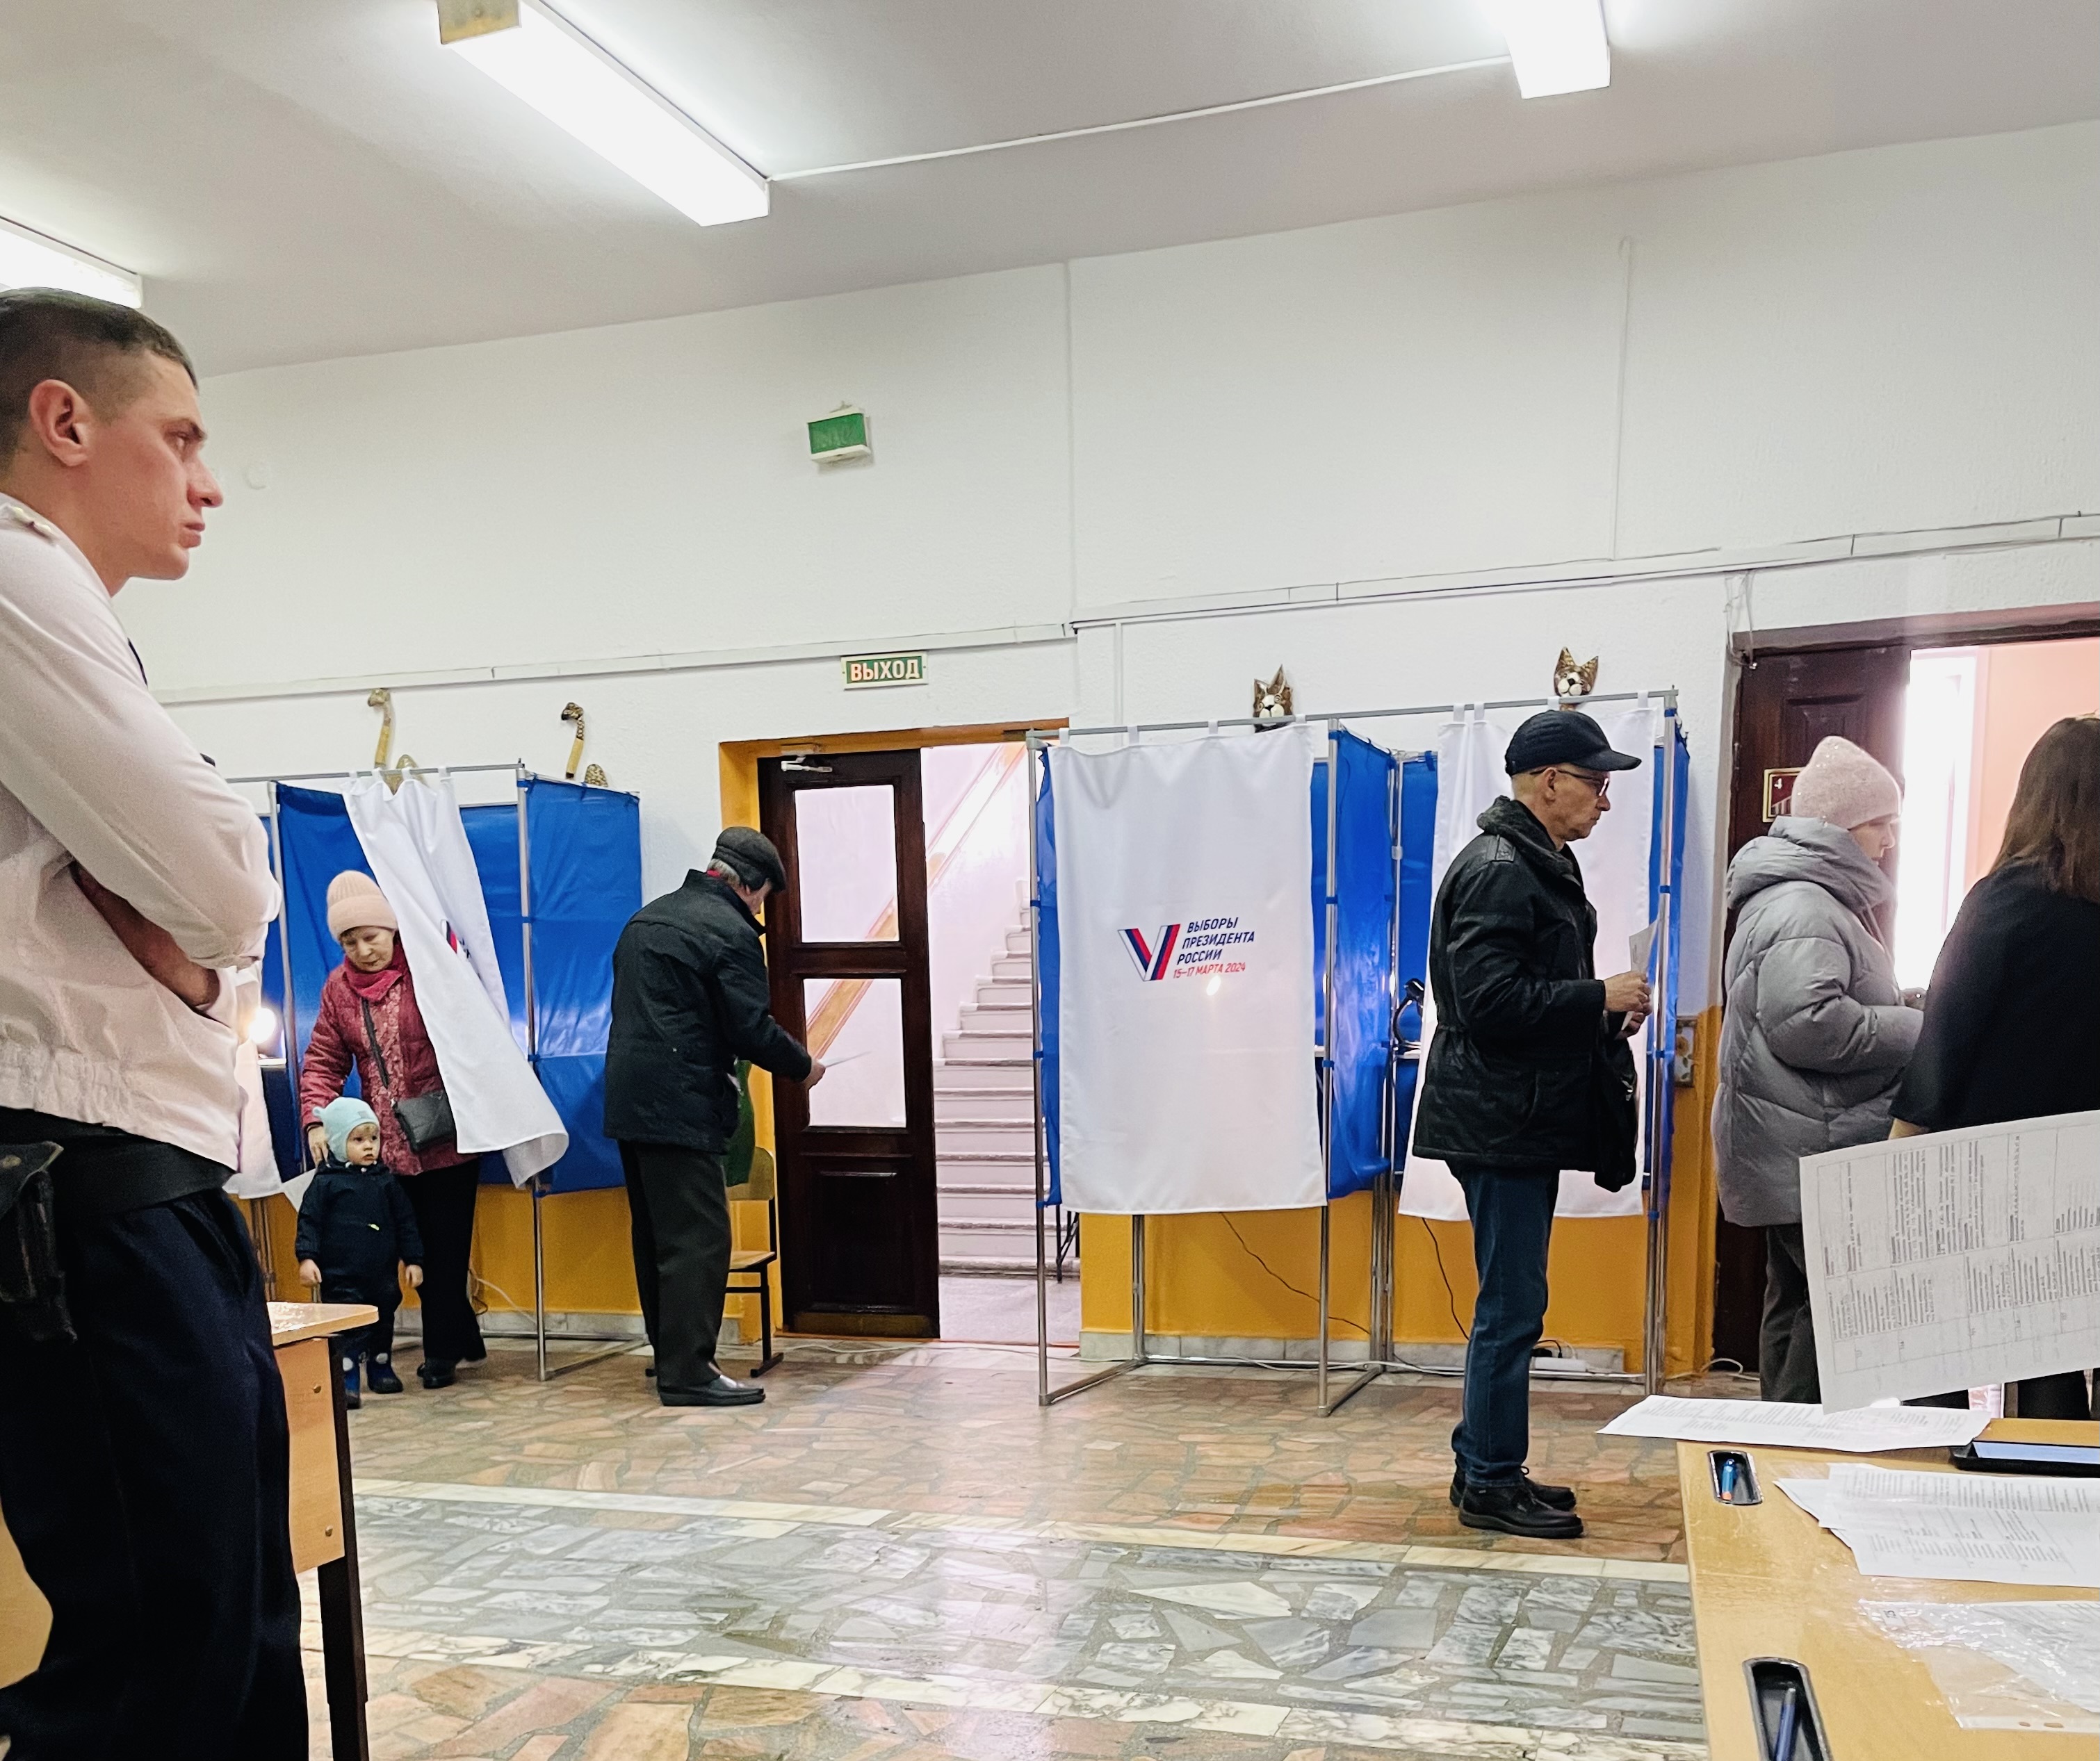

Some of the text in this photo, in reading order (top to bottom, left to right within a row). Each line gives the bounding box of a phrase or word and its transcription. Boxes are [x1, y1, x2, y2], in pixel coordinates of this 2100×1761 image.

[850, 659, 920, 681] ВЫХОД
[1187, 917, 1238, 933] ВЫБОРЫ
[1182, 931, 1255, 949] ПРЕЗИДЕНТА
[1176, 949, 1223, 965] РОССИИ
[1196, 963, 1223, 976] МАРТА
[1225, 962, 1246, 973] 2024
